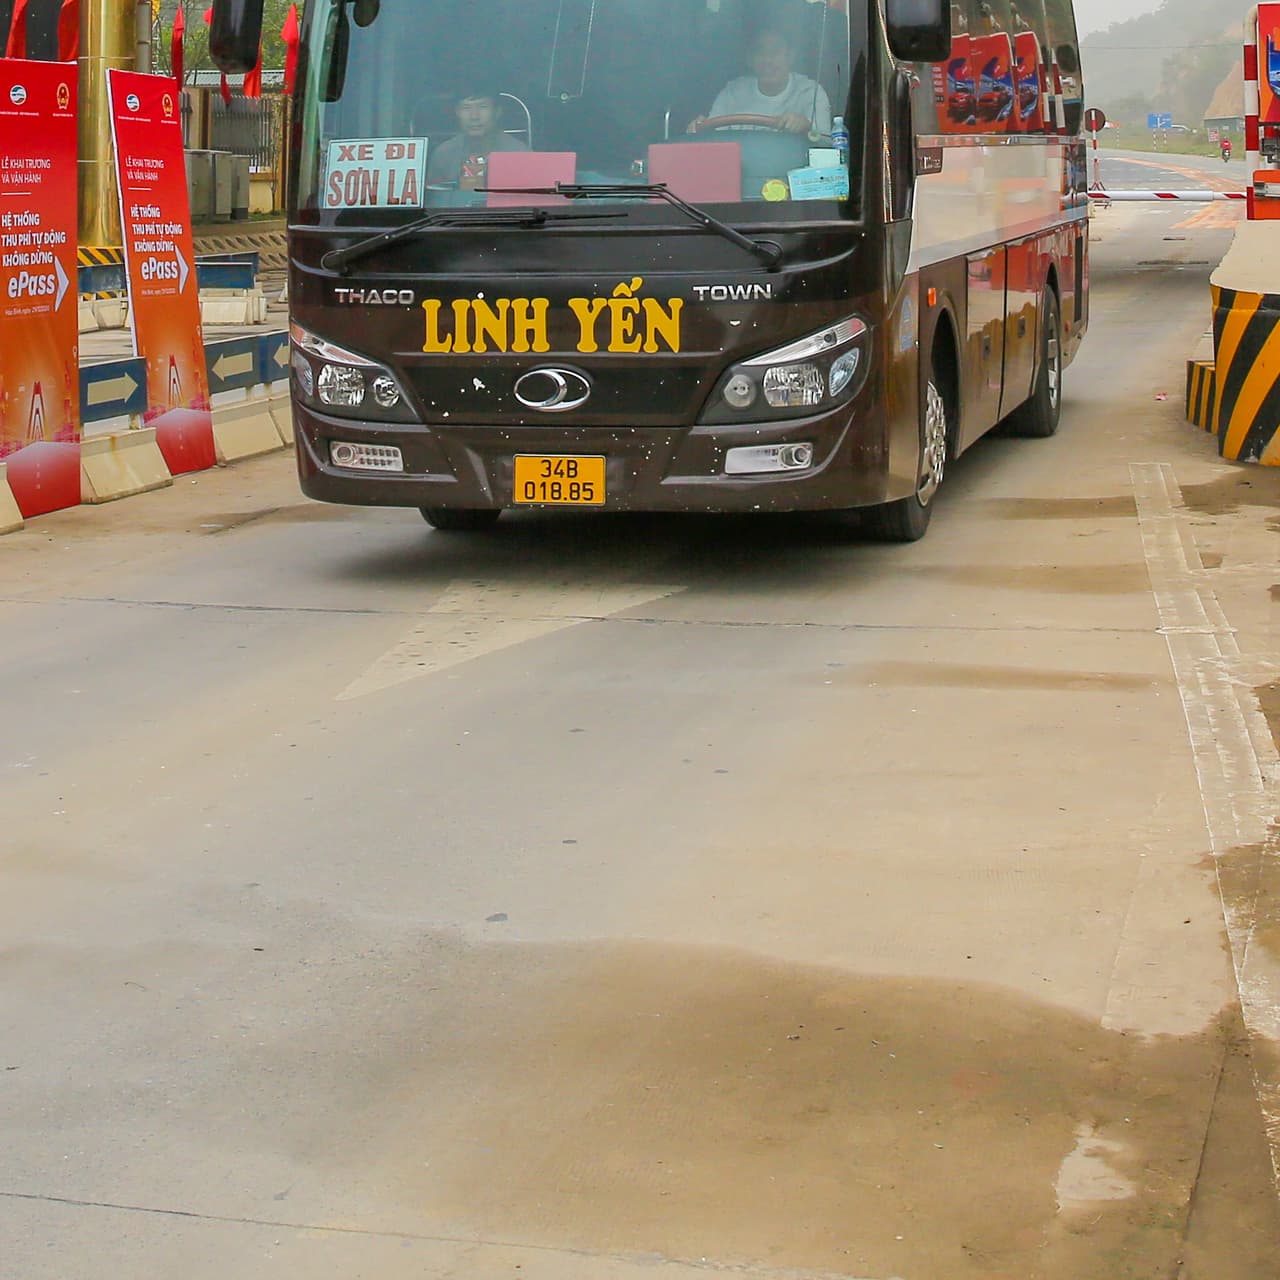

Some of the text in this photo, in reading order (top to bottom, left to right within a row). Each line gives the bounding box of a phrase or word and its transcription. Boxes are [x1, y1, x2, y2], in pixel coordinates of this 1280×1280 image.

[337, 143, 416, 162] XE ĐI
[327, 167, 418, 207] SƠN LA
[1, 210, 40, 230] HỆ THỐNG
[1, 229, 66, 248] THU PHÍ TỰ ĐỘNG
[2, 249, 53, 267] KHÔNG DỪNG
[141, 256, 178, 281] ePass
[8, 271, 56, 298] ePass
[692, 283, 773, 302] TOWN
[334, 288, 416, 306] THACO
[421, 276, 685, 354] LINH YẾN
[540, 459, 579, 479] 34B
[524, 481, 595, 501] 018.85
